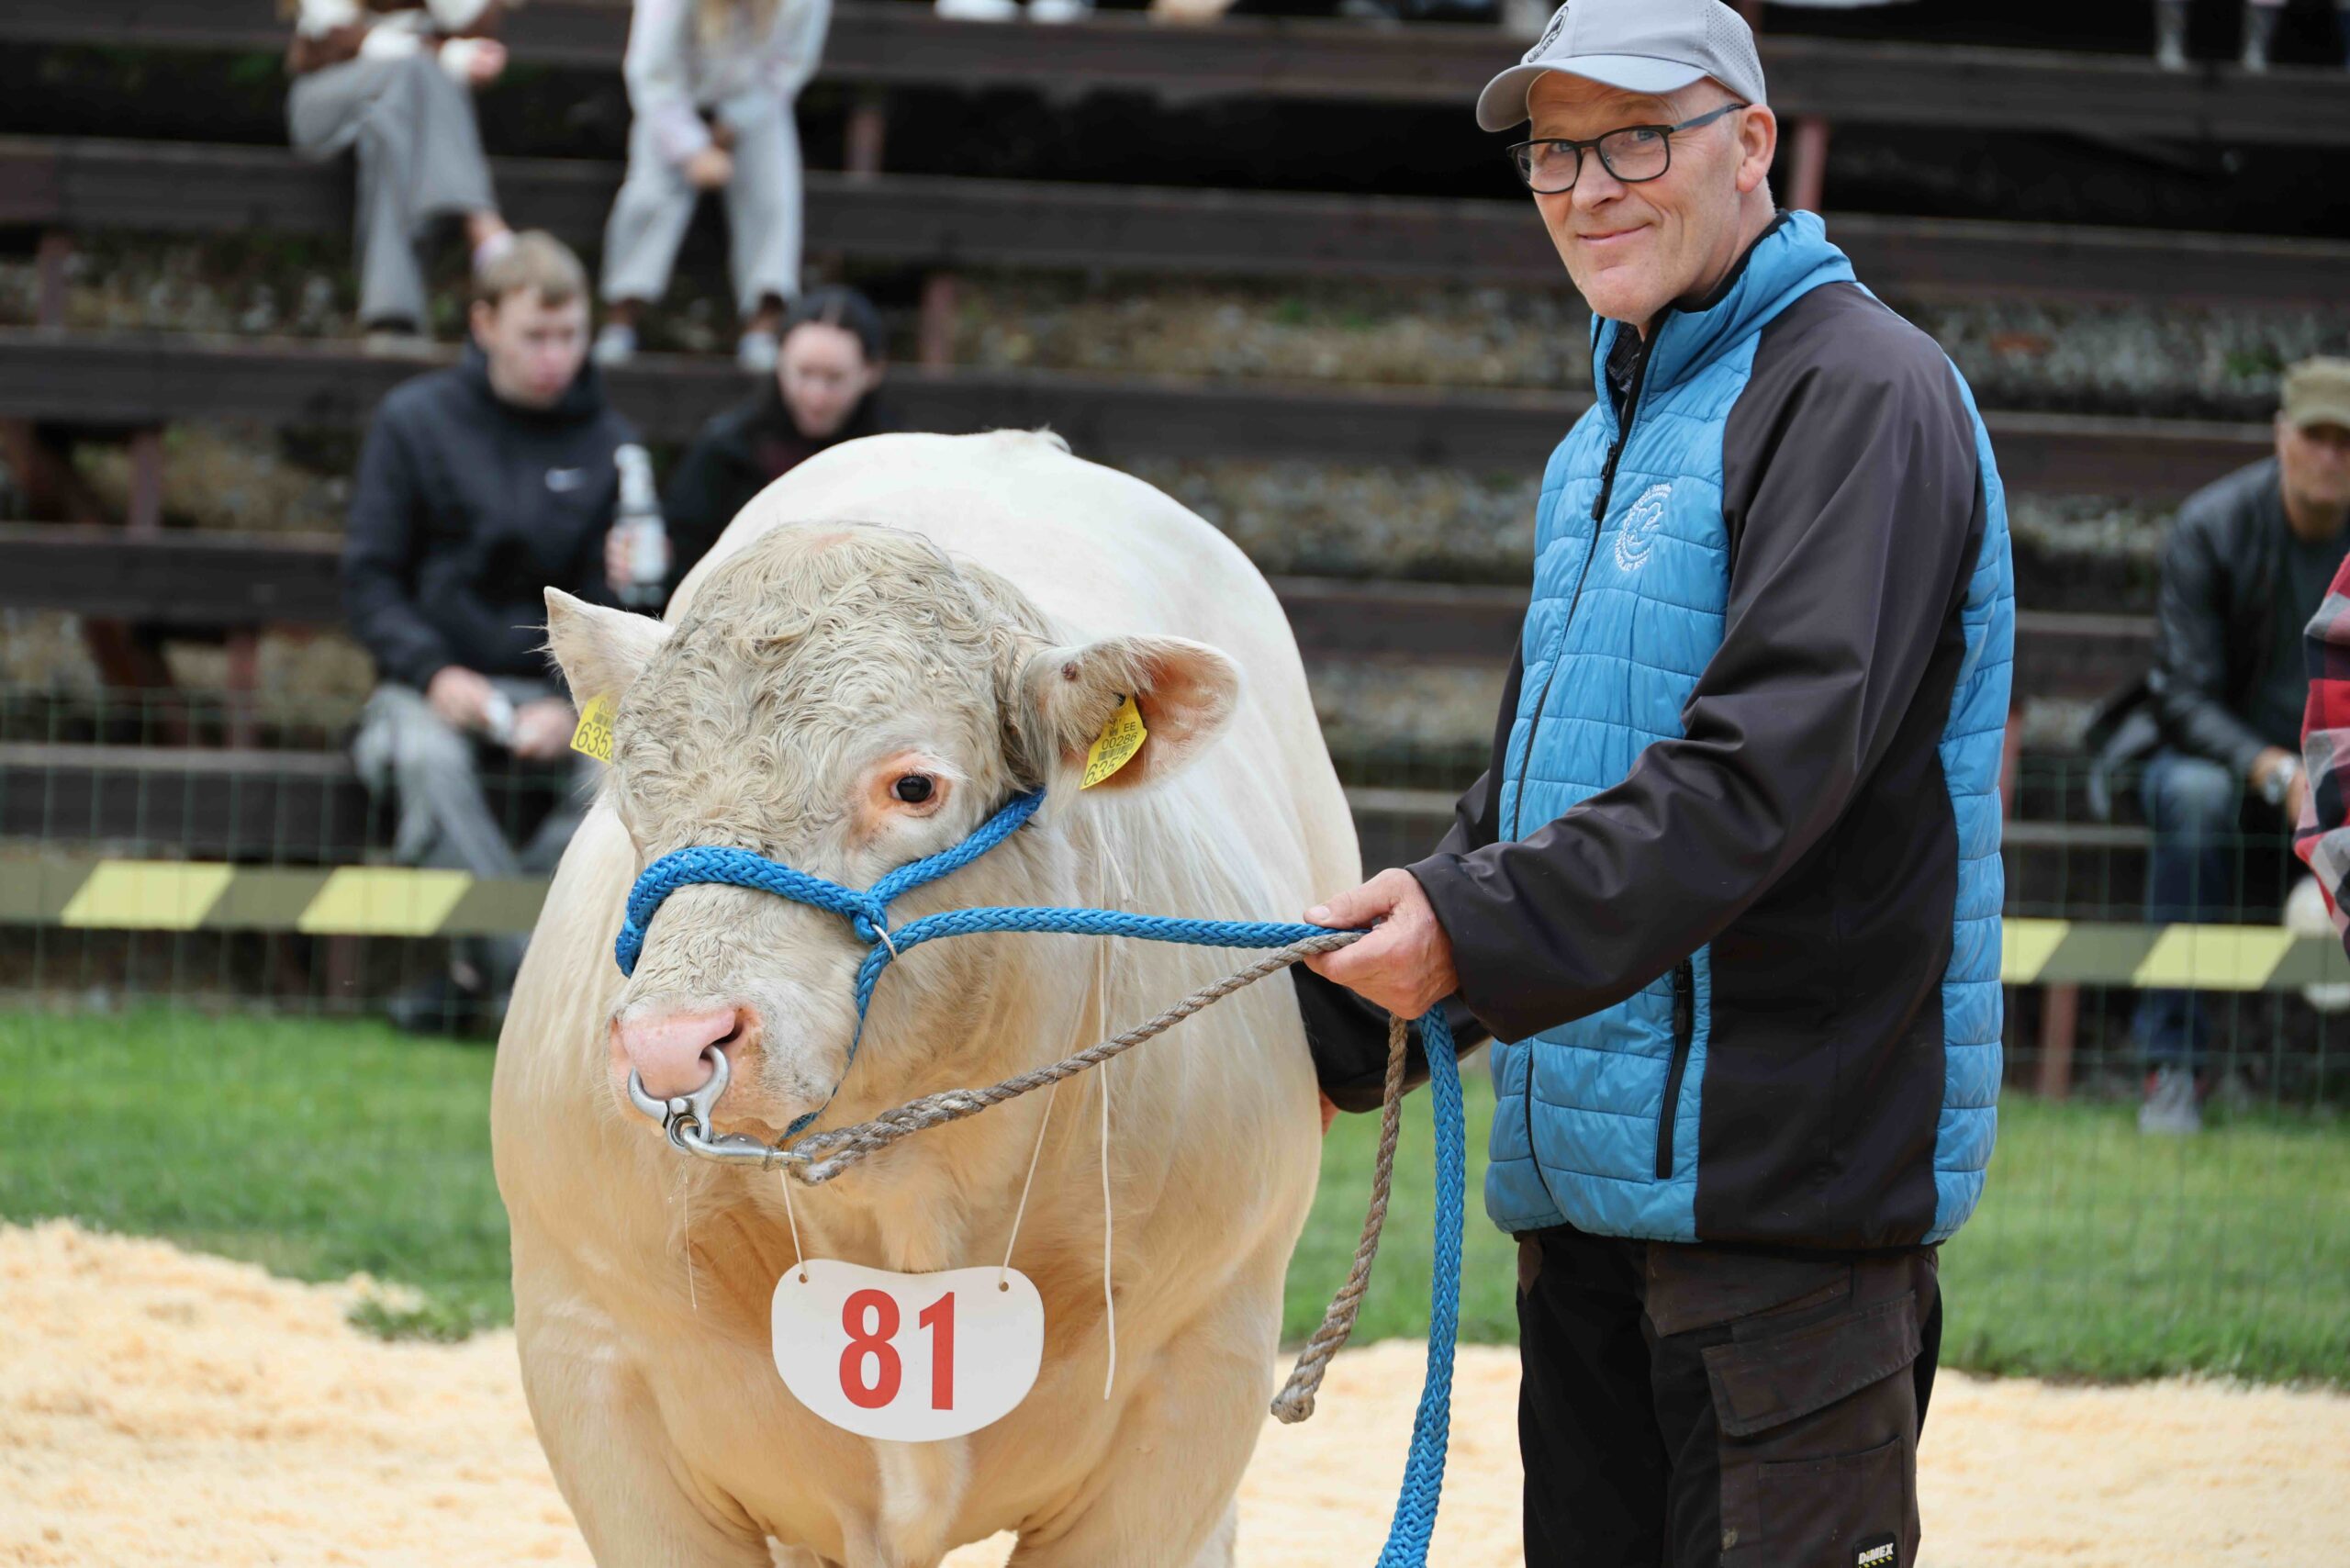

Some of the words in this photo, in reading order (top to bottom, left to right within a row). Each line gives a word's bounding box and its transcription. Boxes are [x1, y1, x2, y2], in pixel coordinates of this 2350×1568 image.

[1124, 722, 1136, 733] EE
[1102, 733, 1137, 749] 00286
[839, 1288, 955, 1410] 81
